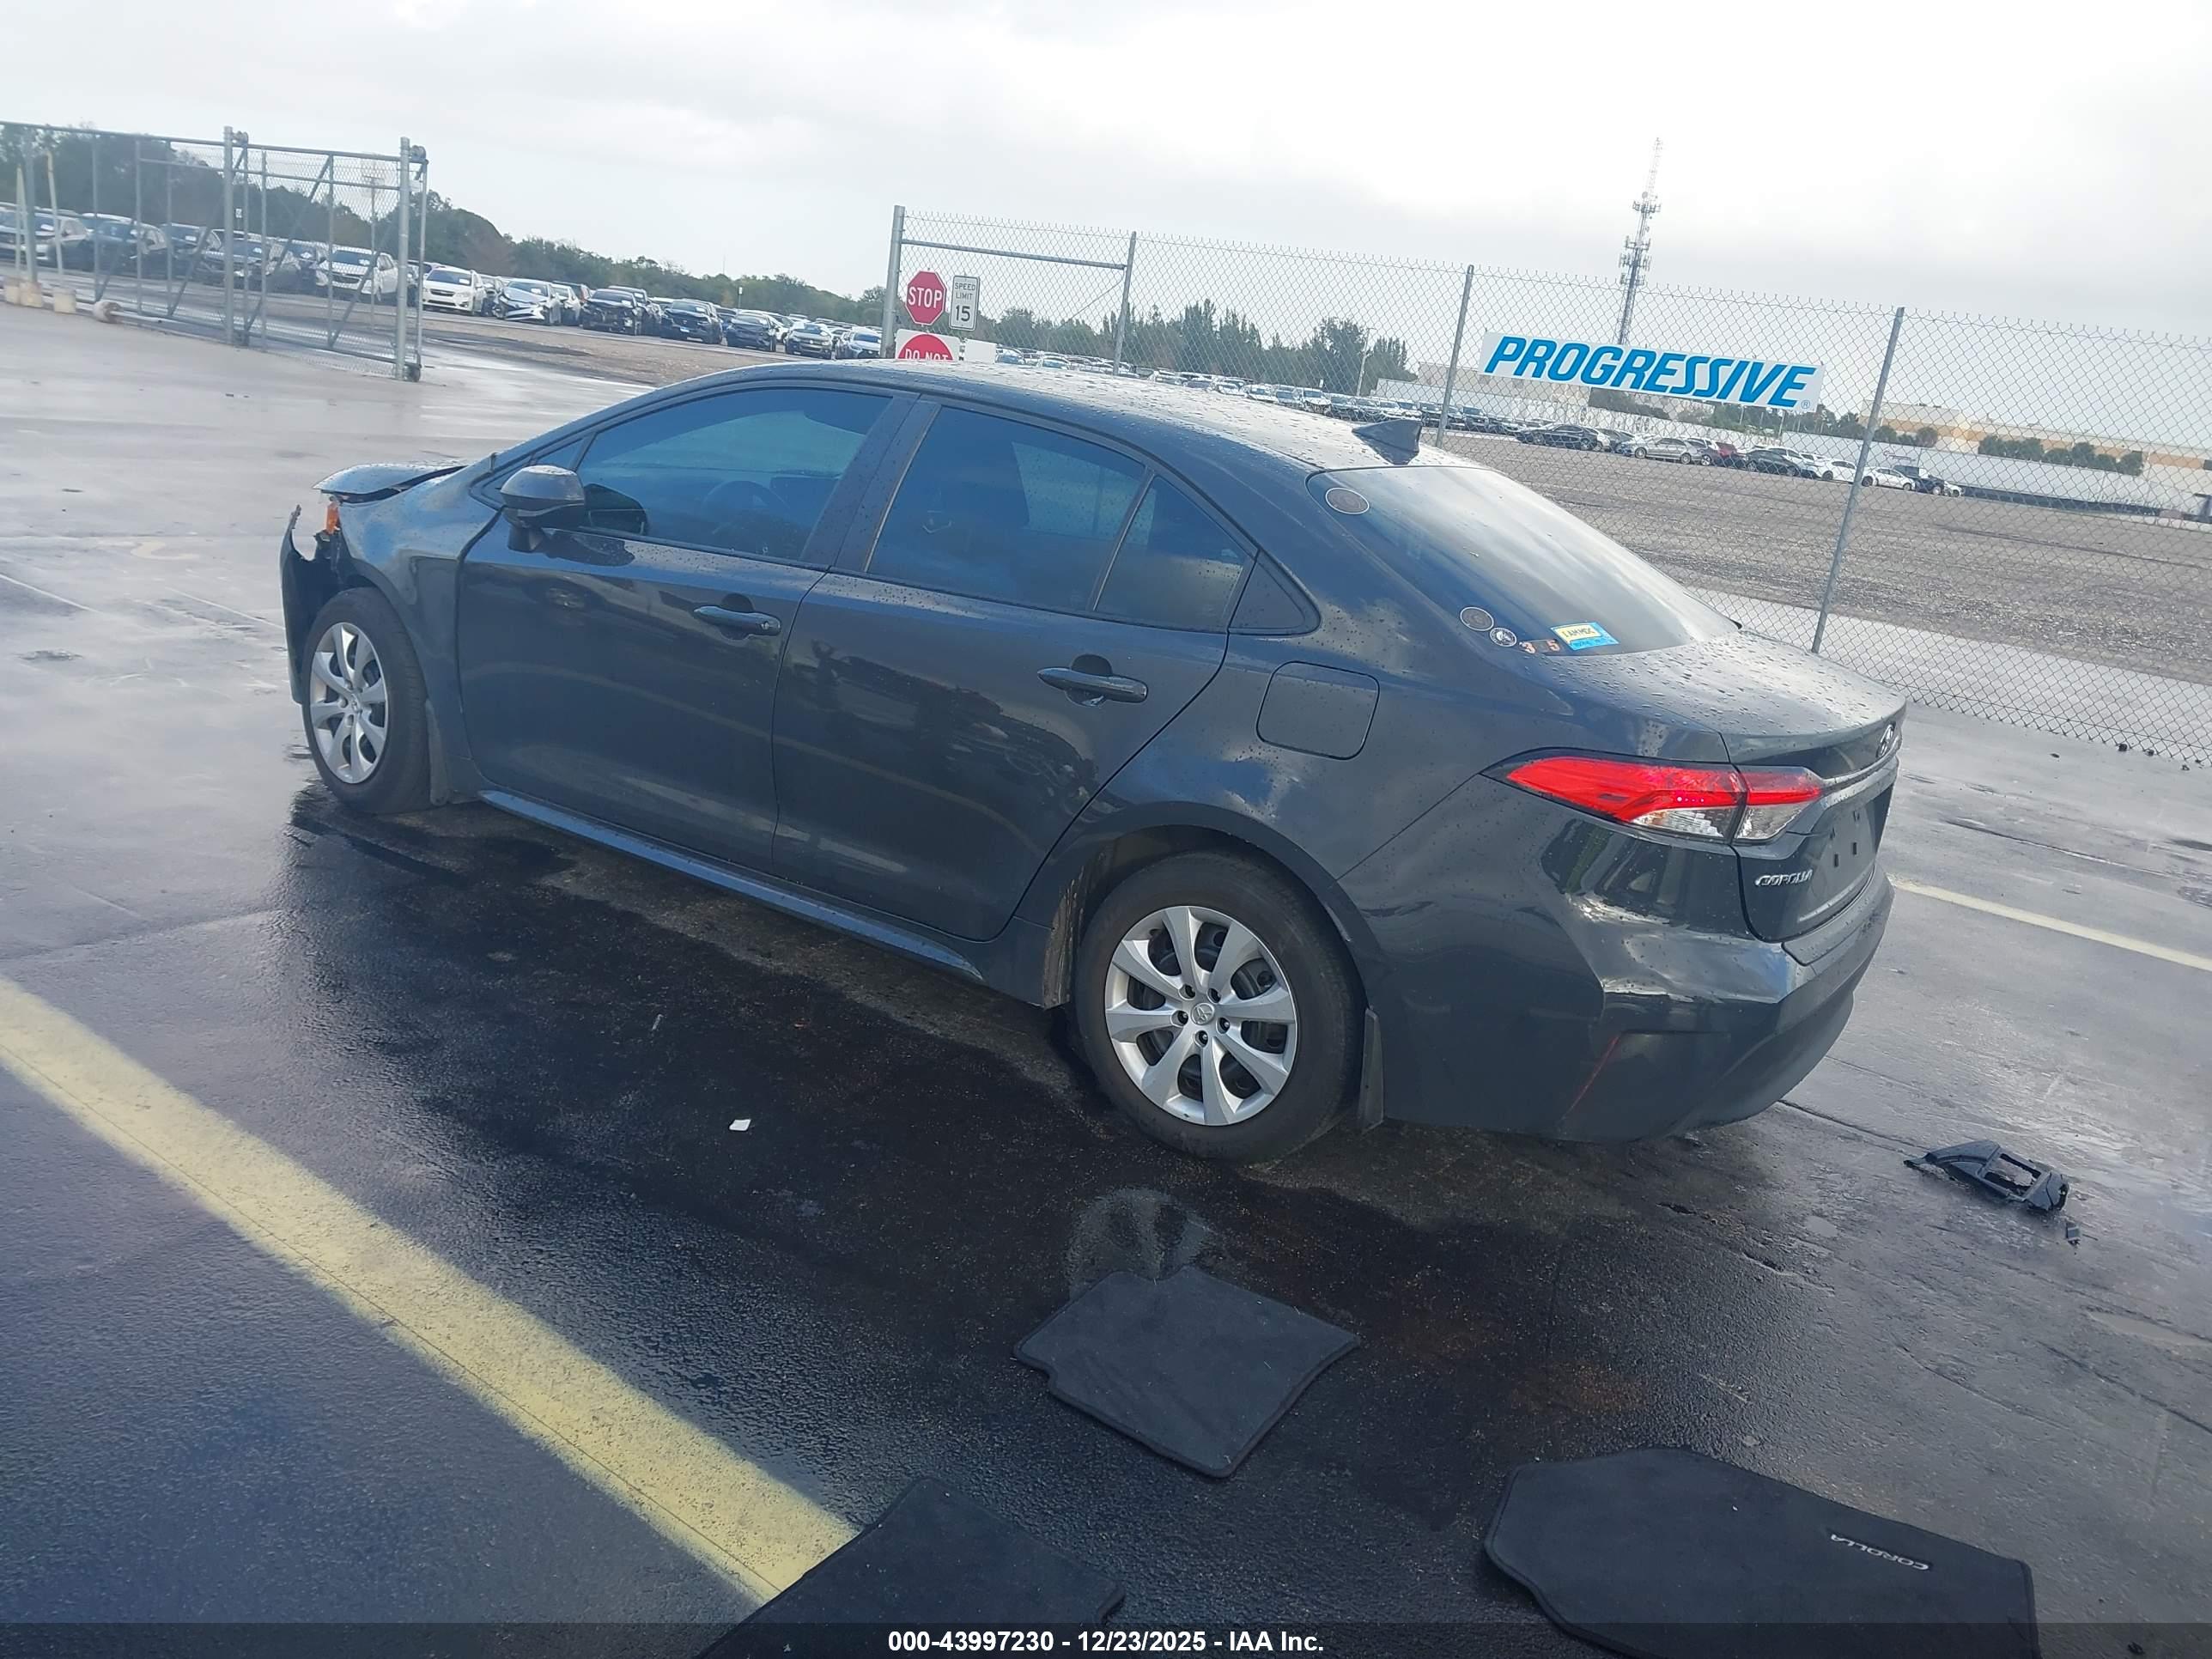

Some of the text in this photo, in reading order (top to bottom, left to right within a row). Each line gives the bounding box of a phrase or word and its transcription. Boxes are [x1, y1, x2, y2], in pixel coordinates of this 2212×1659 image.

[908, 286, 943, 309] STOP
[954, 282, 976, 292] SPEED
[955, 305, 971, 322] 15
[1484, 335, 1818, 408] PROGRESSIVE
[1830, 1534, 1929, 1571] COROLLA
